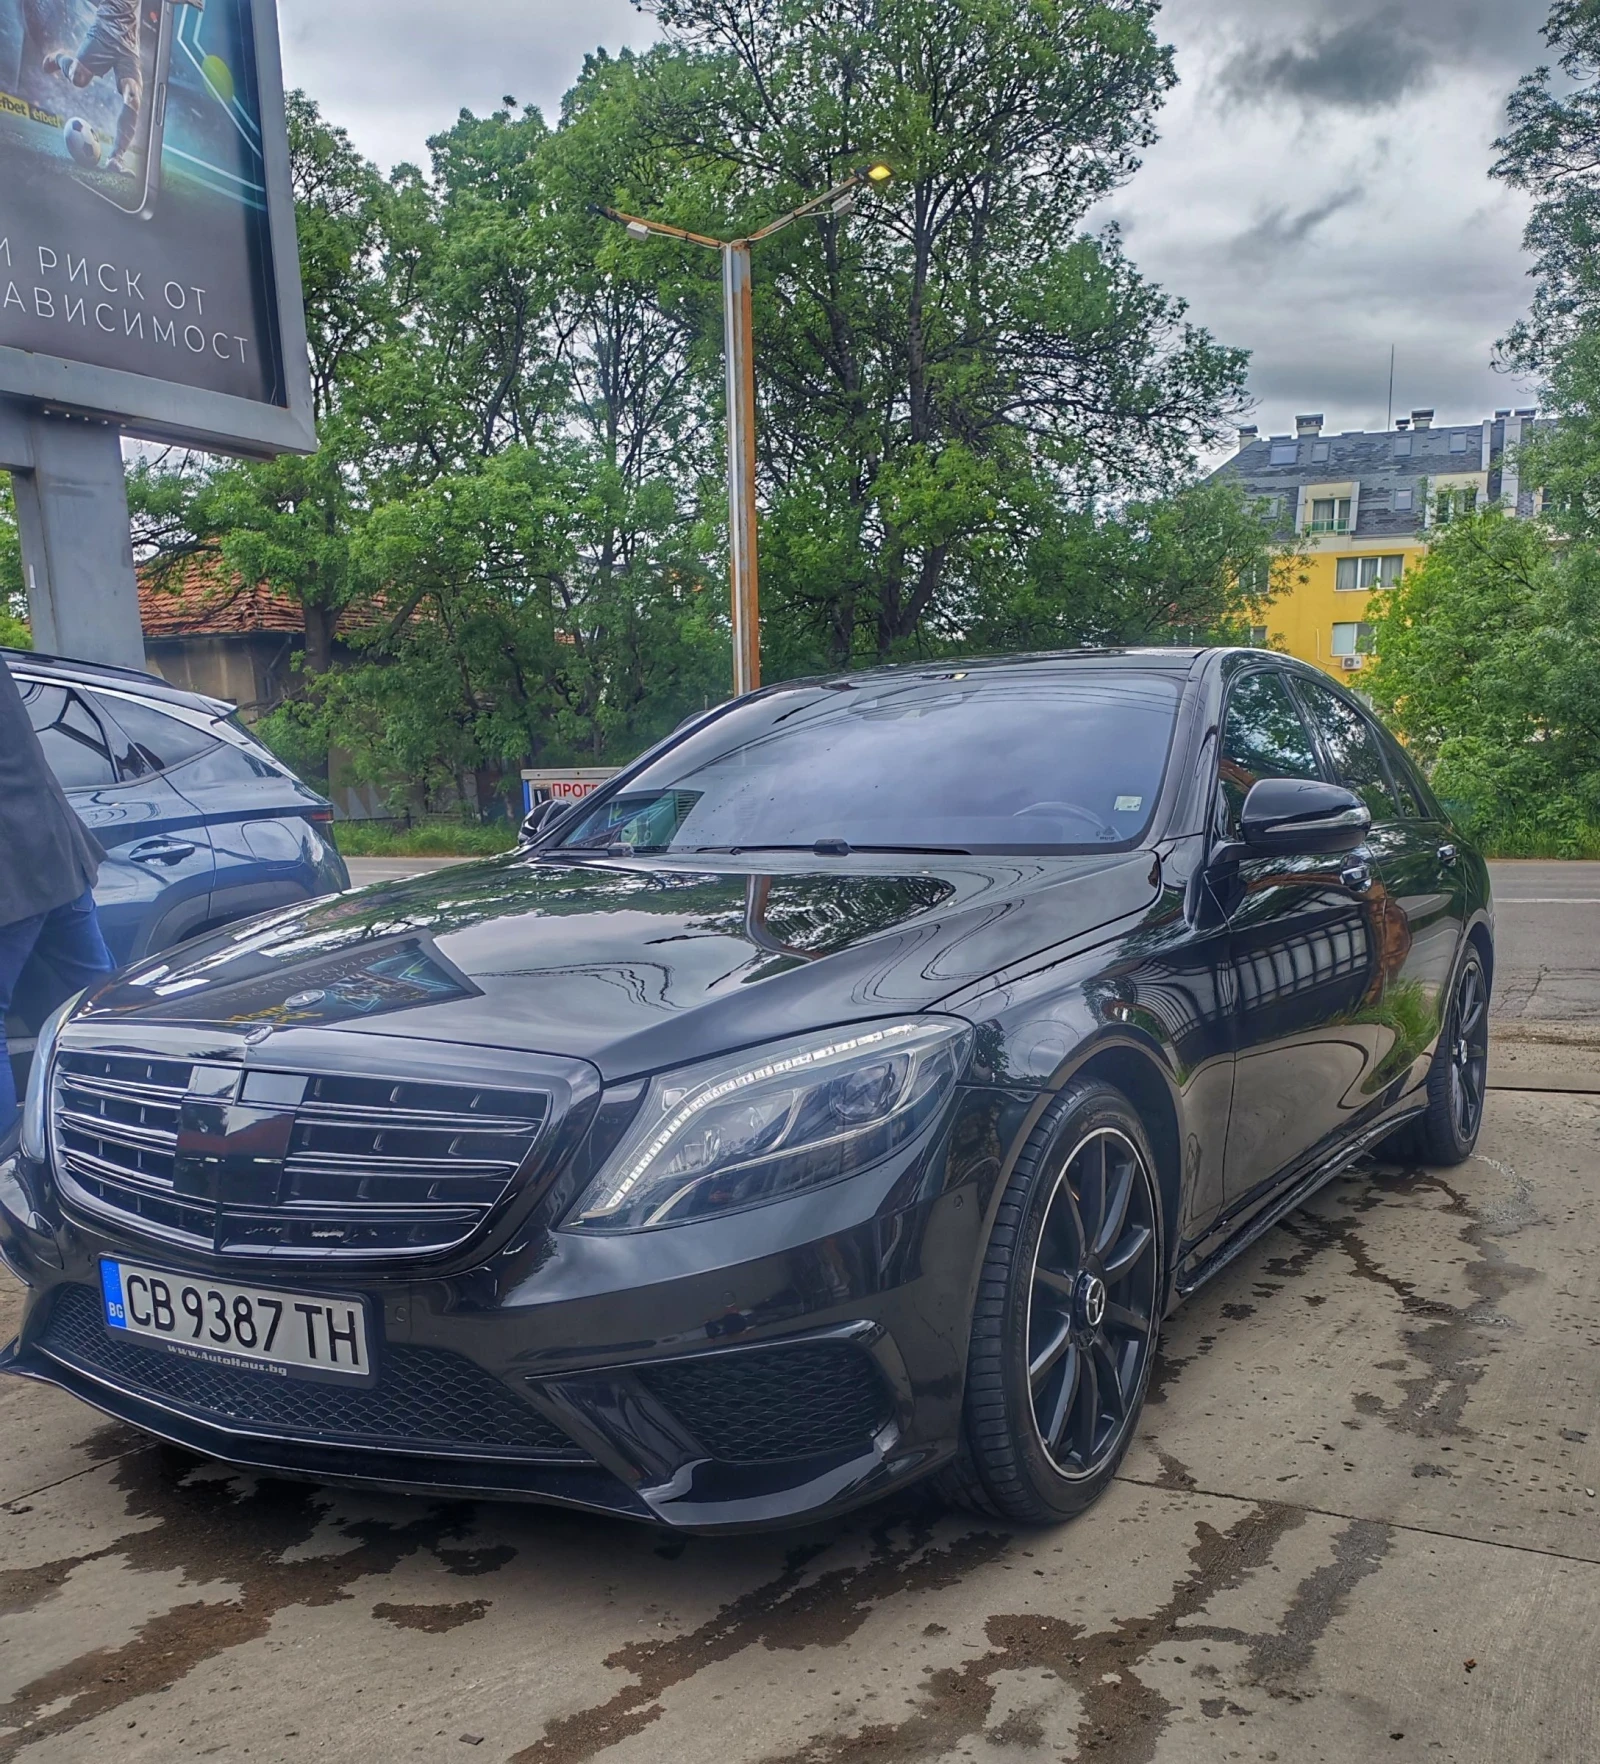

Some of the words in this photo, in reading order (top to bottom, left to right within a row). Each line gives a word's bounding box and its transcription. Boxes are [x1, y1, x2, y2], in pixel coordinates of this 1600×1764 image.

[0, 96, 27, 116] fbet
[38, 246, 145, 300] РИСК
[164, 280, 207, 315] ОТ
[3, 280, 249, 365] АВИСИМОСТ
[108, 1301, 125, 1320] BG
[127, 1274, 175, 1332] CB
[181, 1287, 283, 1352] 9387
[294, 1302, 361, 1367] TH
[166, 1343, 288, 1378] www.AutoHaus.bg
